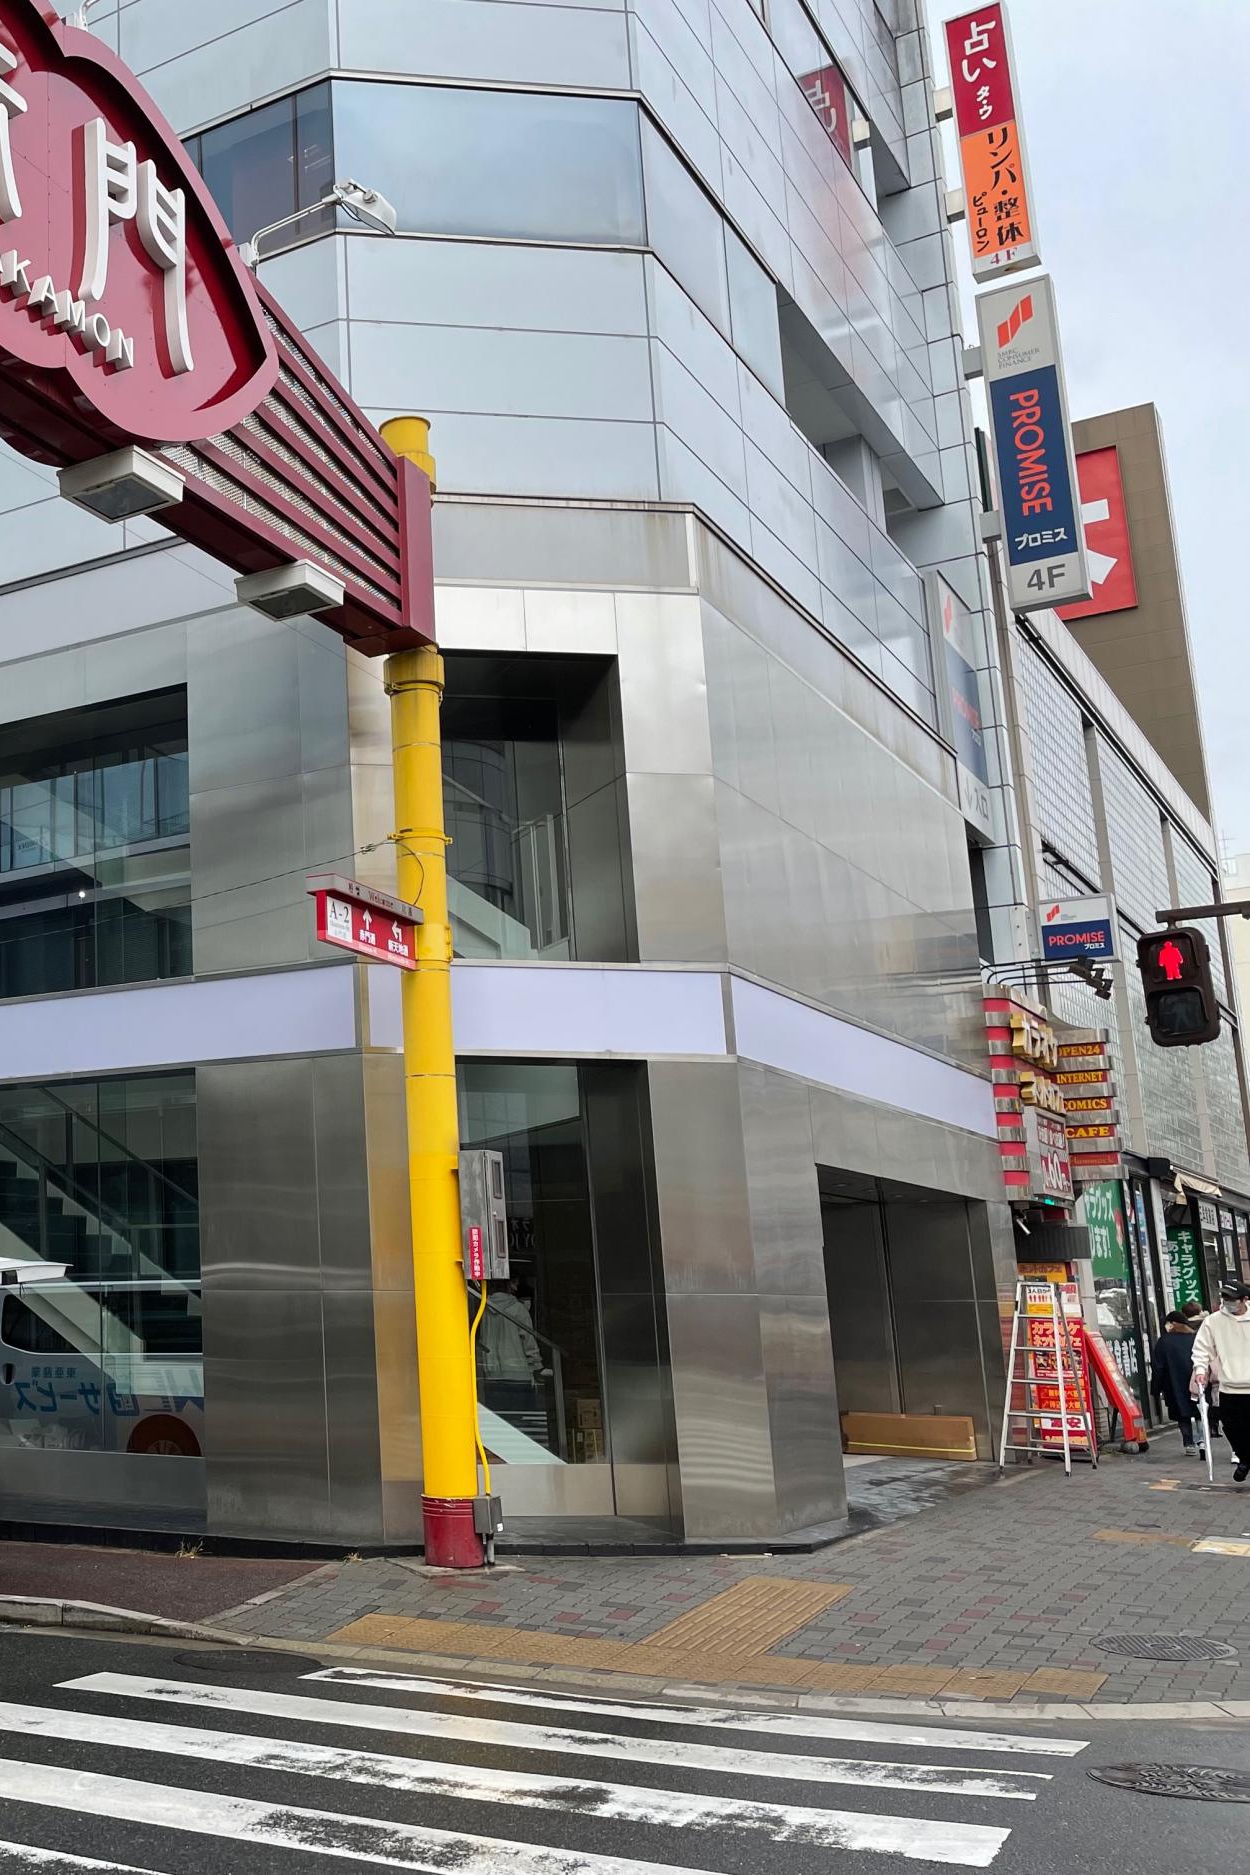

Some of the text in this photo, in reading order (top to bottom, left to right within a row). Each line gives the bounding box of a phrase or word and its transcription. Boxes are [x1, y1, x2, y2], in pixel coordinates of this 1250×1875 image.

[961, 20, 997, 83] 占い
[988, 127, 1024, 246] リンパ・整体
[973, 191, 990, 253] ピューロン
[1009, 388, 1053, 516] PROMISE
[1014, 527, 1068, 550] プロミス
[1026, 563, 1066, 591] 4F
[329, 901, 350, 924] A-2
[1048, 931, 1105, 946] PROMISE
[1084, 942, 1105, 950] プロミス
[1056, 1072, 1103, 1084] INTERNET
[1063, 1099, 1107, 1111] COMICS
[1066, 1126, 1110, 1138] CAFE
[1178, 1231, 1199, 1302] キャラグッズ
